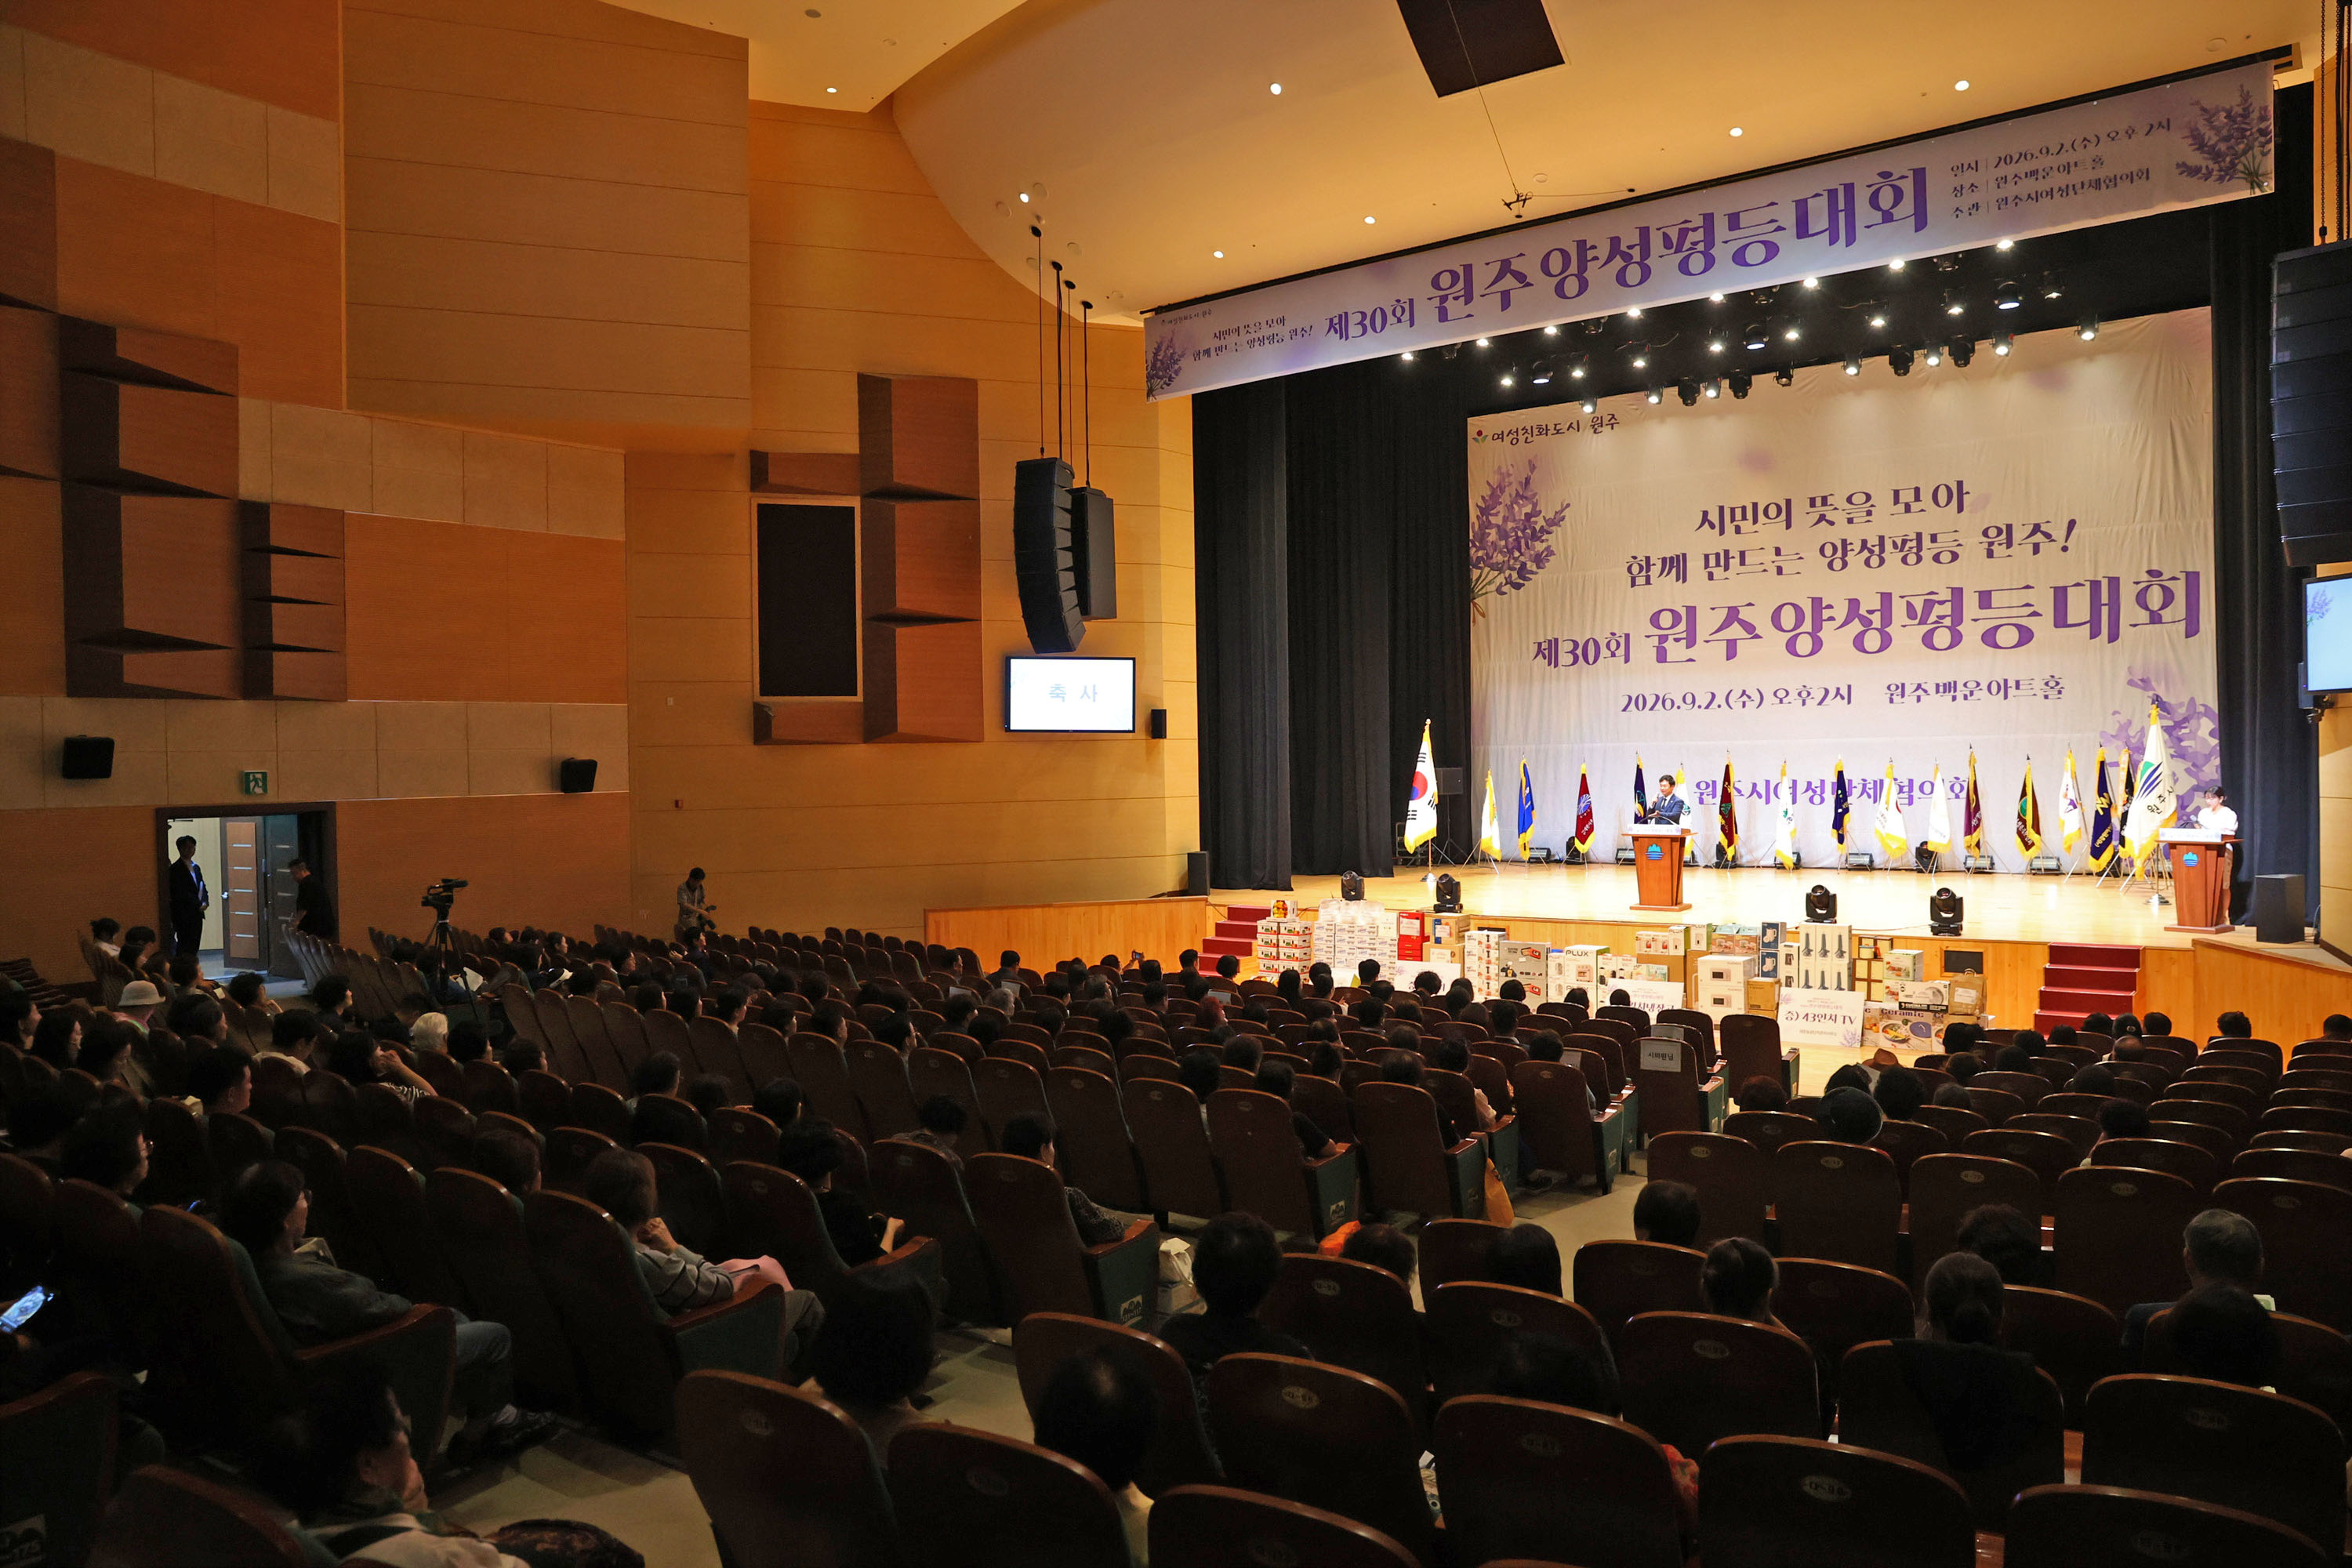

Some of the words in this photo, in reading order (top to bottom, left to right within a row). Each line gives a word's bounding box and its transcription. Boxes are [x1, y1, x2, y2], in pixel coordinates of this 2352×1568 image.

[2107, 125, 2137, 142] 오후
[1951, 182, 1979, 198] 장소
[1952, 201, 1981, 219] 주관
[1325, 297, 1414, 342] 제30회
[1491, 419, 1581, 446] 여성친화도시
[1589, 413, 1620, 434] 원주
[1694, 497, 1792, 537] 시민의
[1805, 491, 1877, 528] 뜻을
[1889, 480, 1971, 517] 모아
[1625, 552, 1687, 589] 함께
[1703, 546, 1805, 582] 만드는
[1819, 529, 1965, 572] 양성평등
[1979, 518, 2078, 560] 원주!
[1532, 631, 1631, 669] 제30회
[1621, 687, 1764, 713] 2026.9.2.(수)
[1771, 684, 1853, 706] 오후2시
[1841, 1015, 1857, 1025] TV
